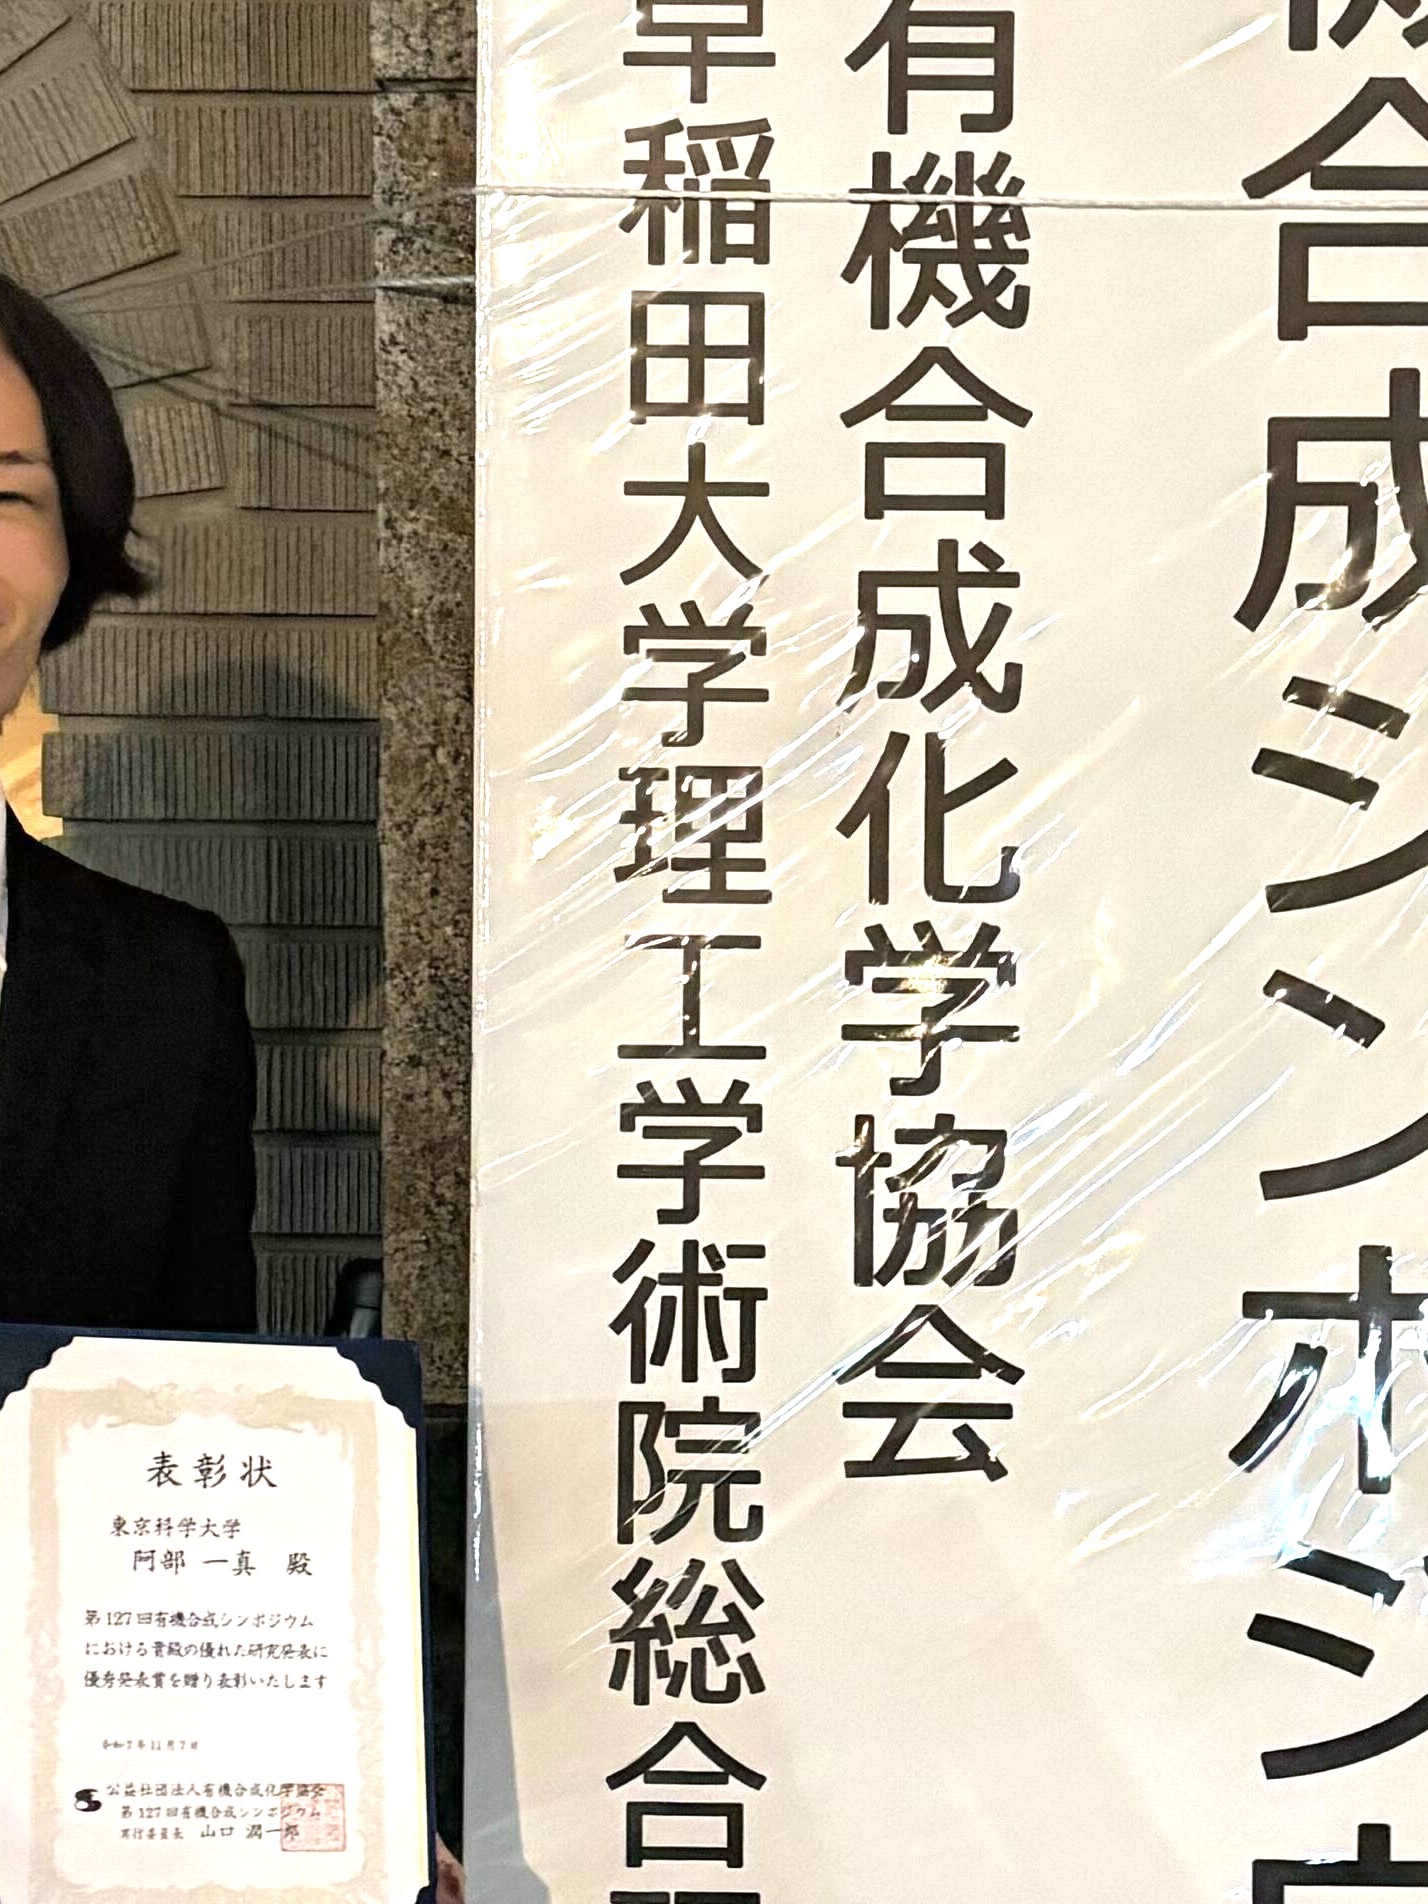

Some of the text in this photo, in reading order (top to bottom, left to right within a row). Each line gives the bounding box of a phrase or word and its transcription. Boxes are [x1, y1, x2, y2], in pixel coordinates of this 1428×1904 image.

[147, 1450, 278, 1489] 表彰状
[110, 1515, 241, 1539] 東京科学大学
[133, 1549, 313, 1576] 阿部 一真 殿
